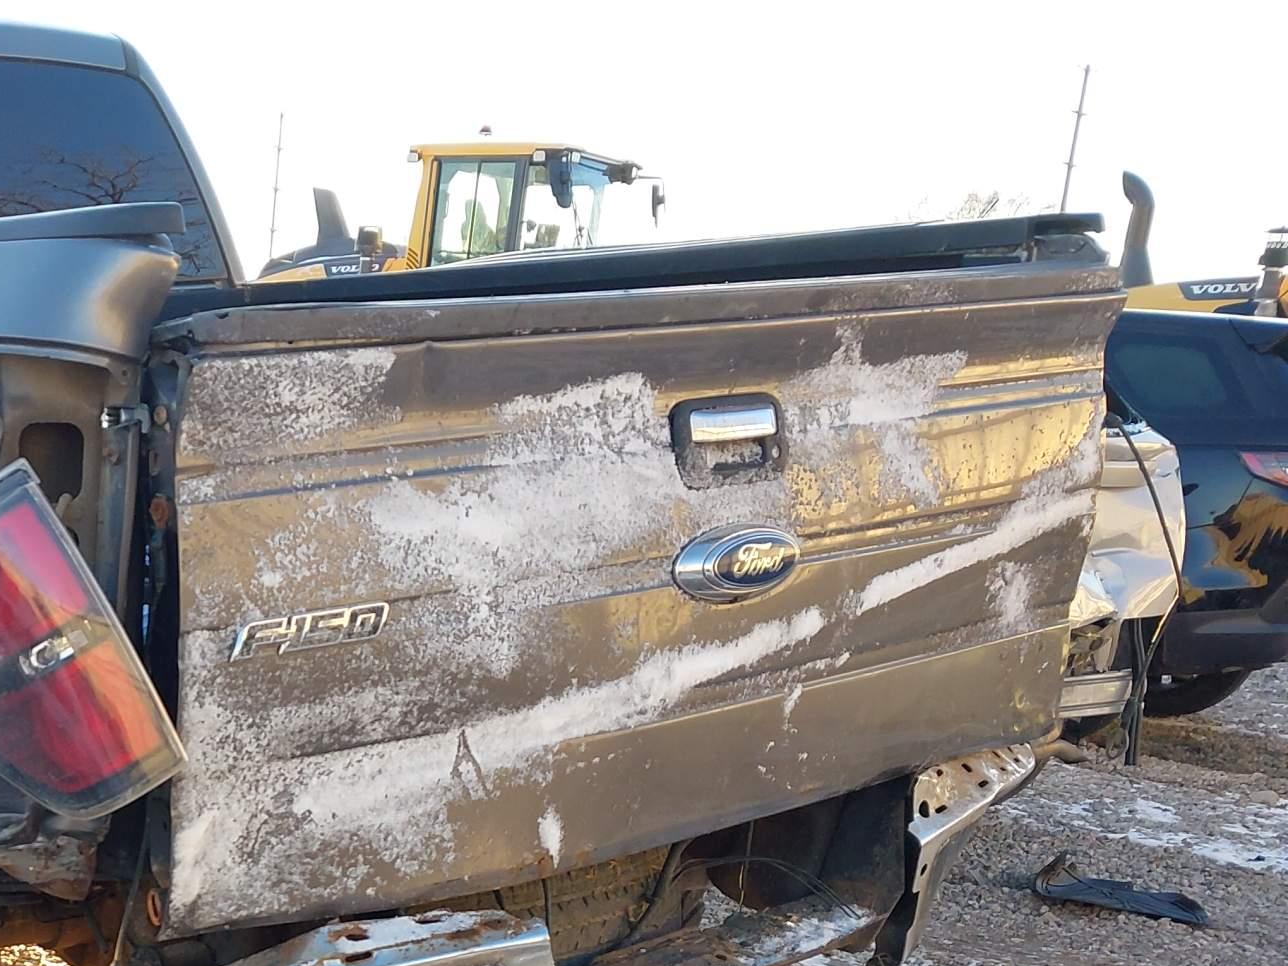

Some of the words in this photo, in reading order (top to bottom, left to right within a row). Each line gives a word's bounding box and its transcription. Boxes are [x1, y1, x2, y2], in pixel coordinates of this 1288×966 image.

[331, 263, 380, 274] VOLO
[1190, 282, 1257, 295] VOLV
[733, 541, 785, 579] Ford
